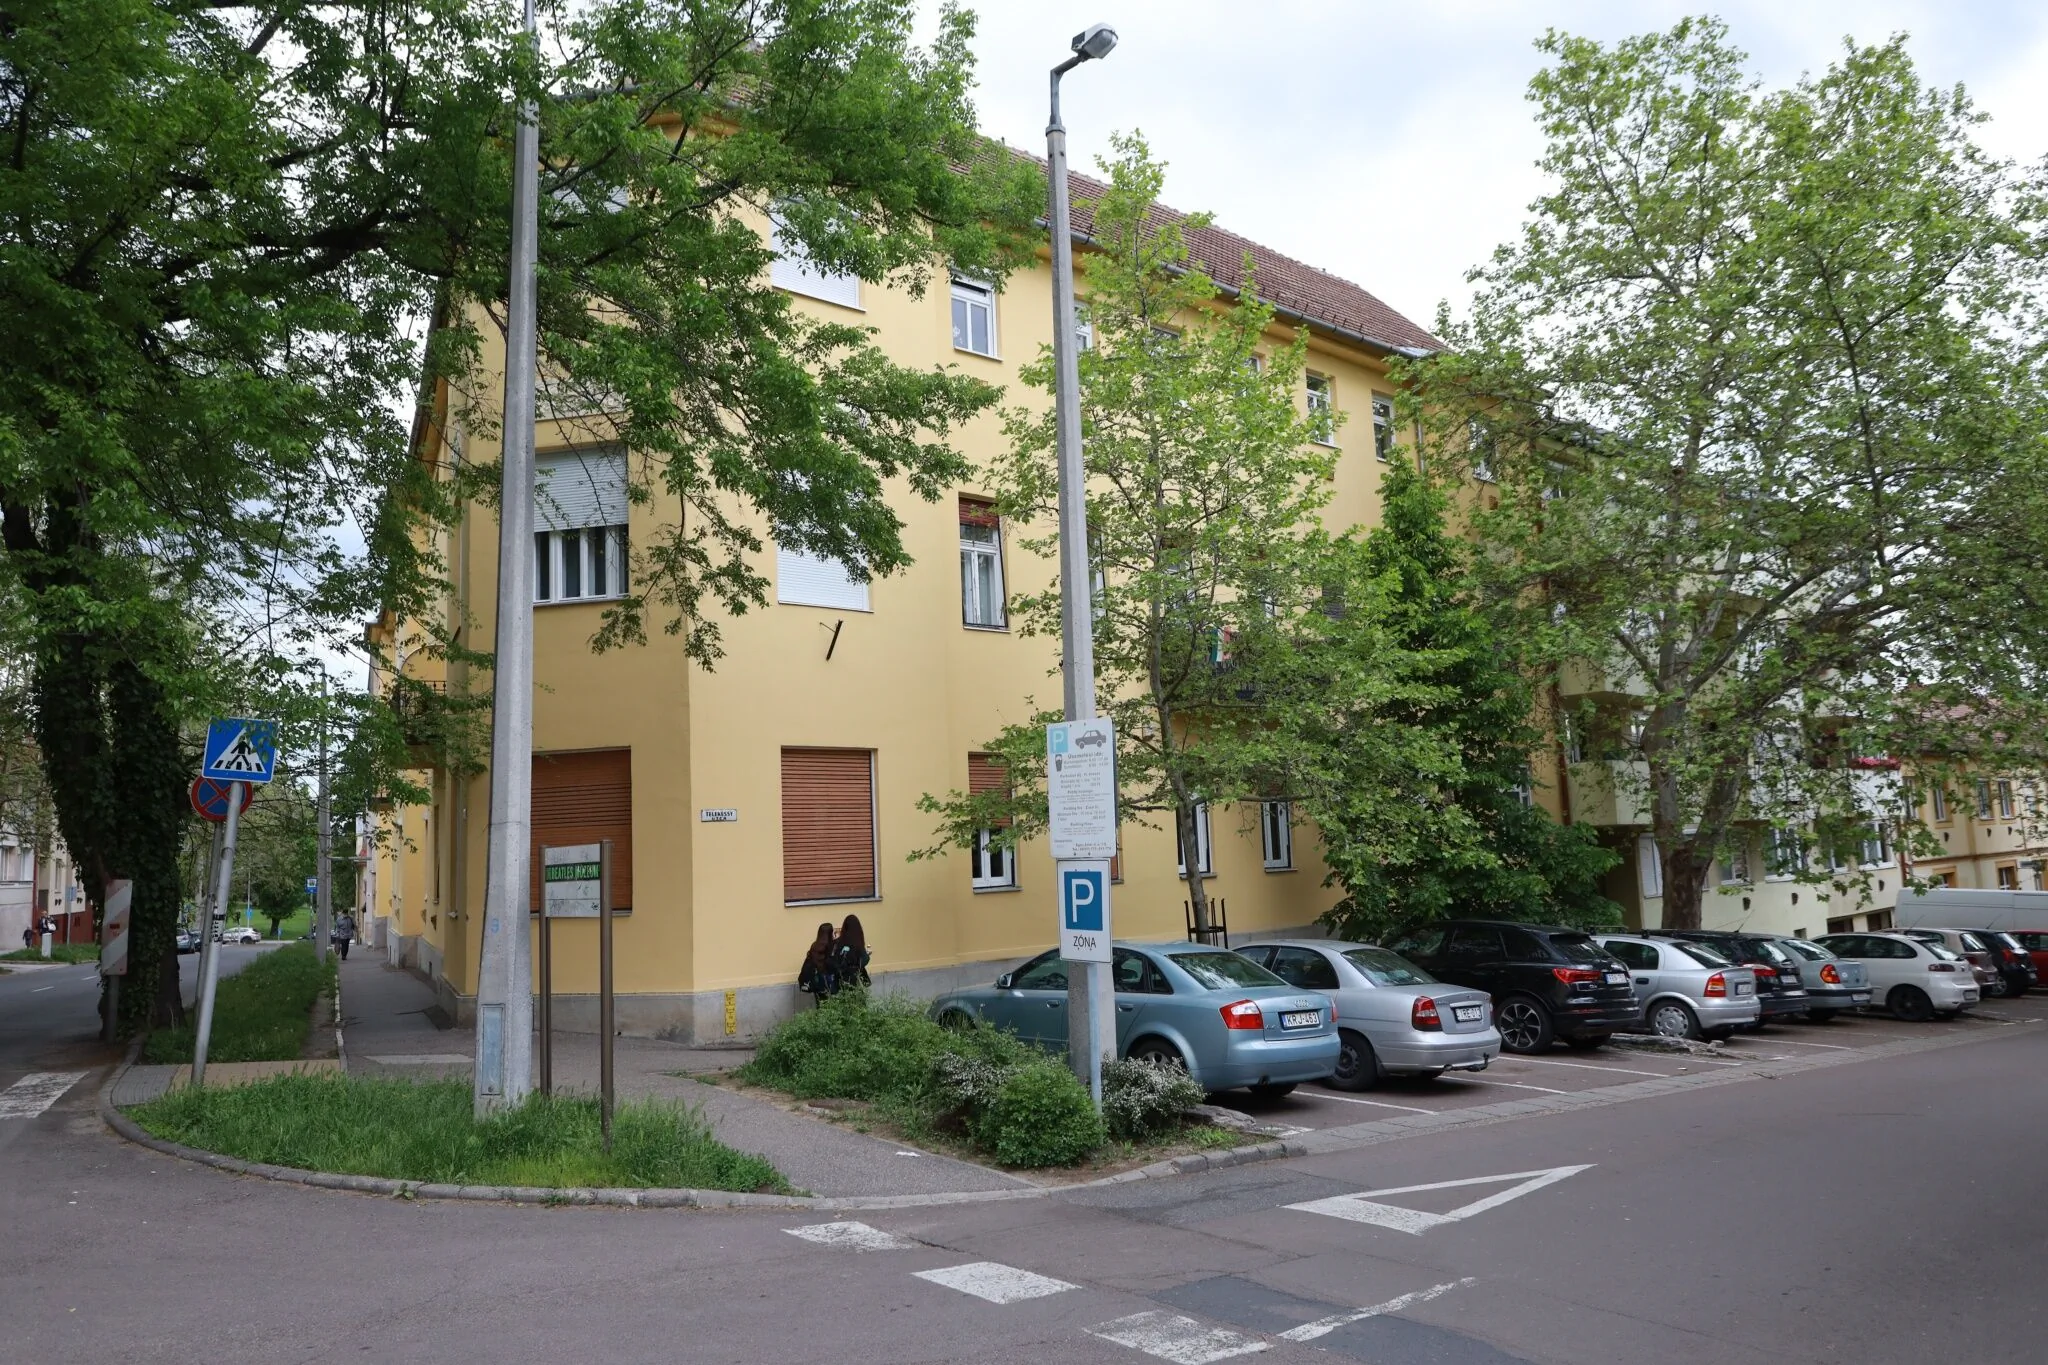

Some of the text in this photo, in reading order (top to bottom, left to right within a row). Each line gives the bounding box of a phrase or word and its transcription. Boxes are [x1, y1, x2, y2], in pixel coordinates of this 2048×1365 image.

[551, 865, 574, 880] BEATLES
[1071, 878, 1095, 923] P
[1073, 934, 1097, 948] ZÓNA
